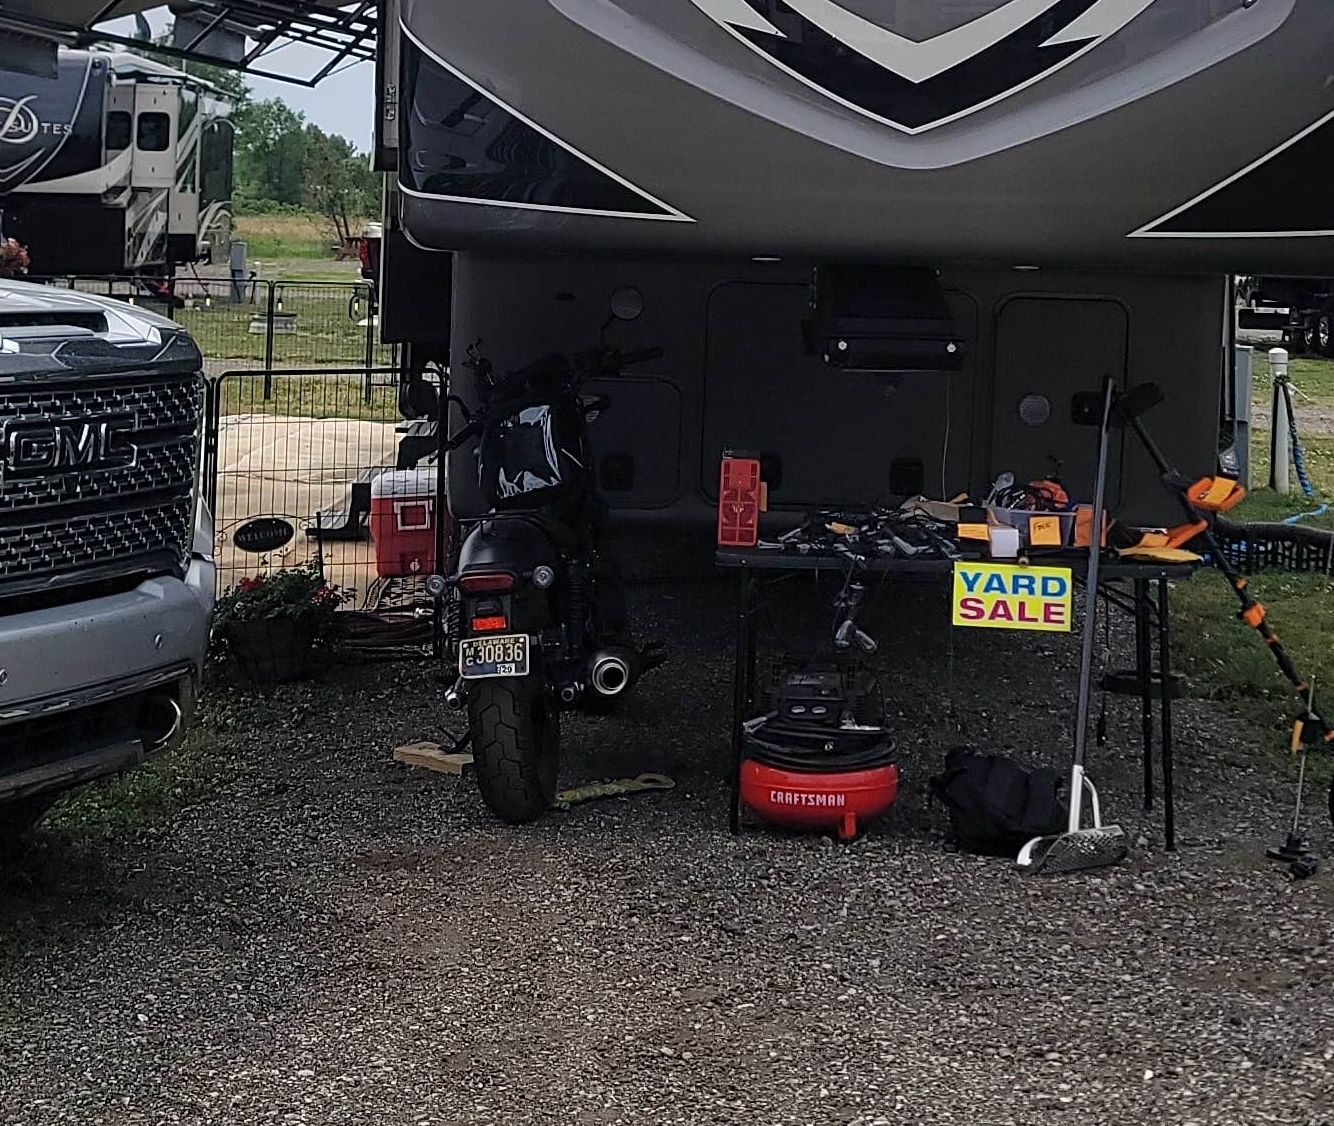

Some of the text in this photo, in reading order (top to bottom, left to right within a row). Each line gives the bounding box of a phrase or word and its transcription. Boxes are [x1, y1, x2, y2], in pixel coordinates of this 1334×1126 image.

[8, 122, 73, 136] SUTES
[5, 415, 139, 473] GMC
[960, 572, 1066, 597] YARD
[960, 597, 1066, 624] SALE
[473, 637, 515, 648] DELAWARE
[476, 643, 523, 664] 30836
[770, 790, 845, 806] CRAFTSMAN
